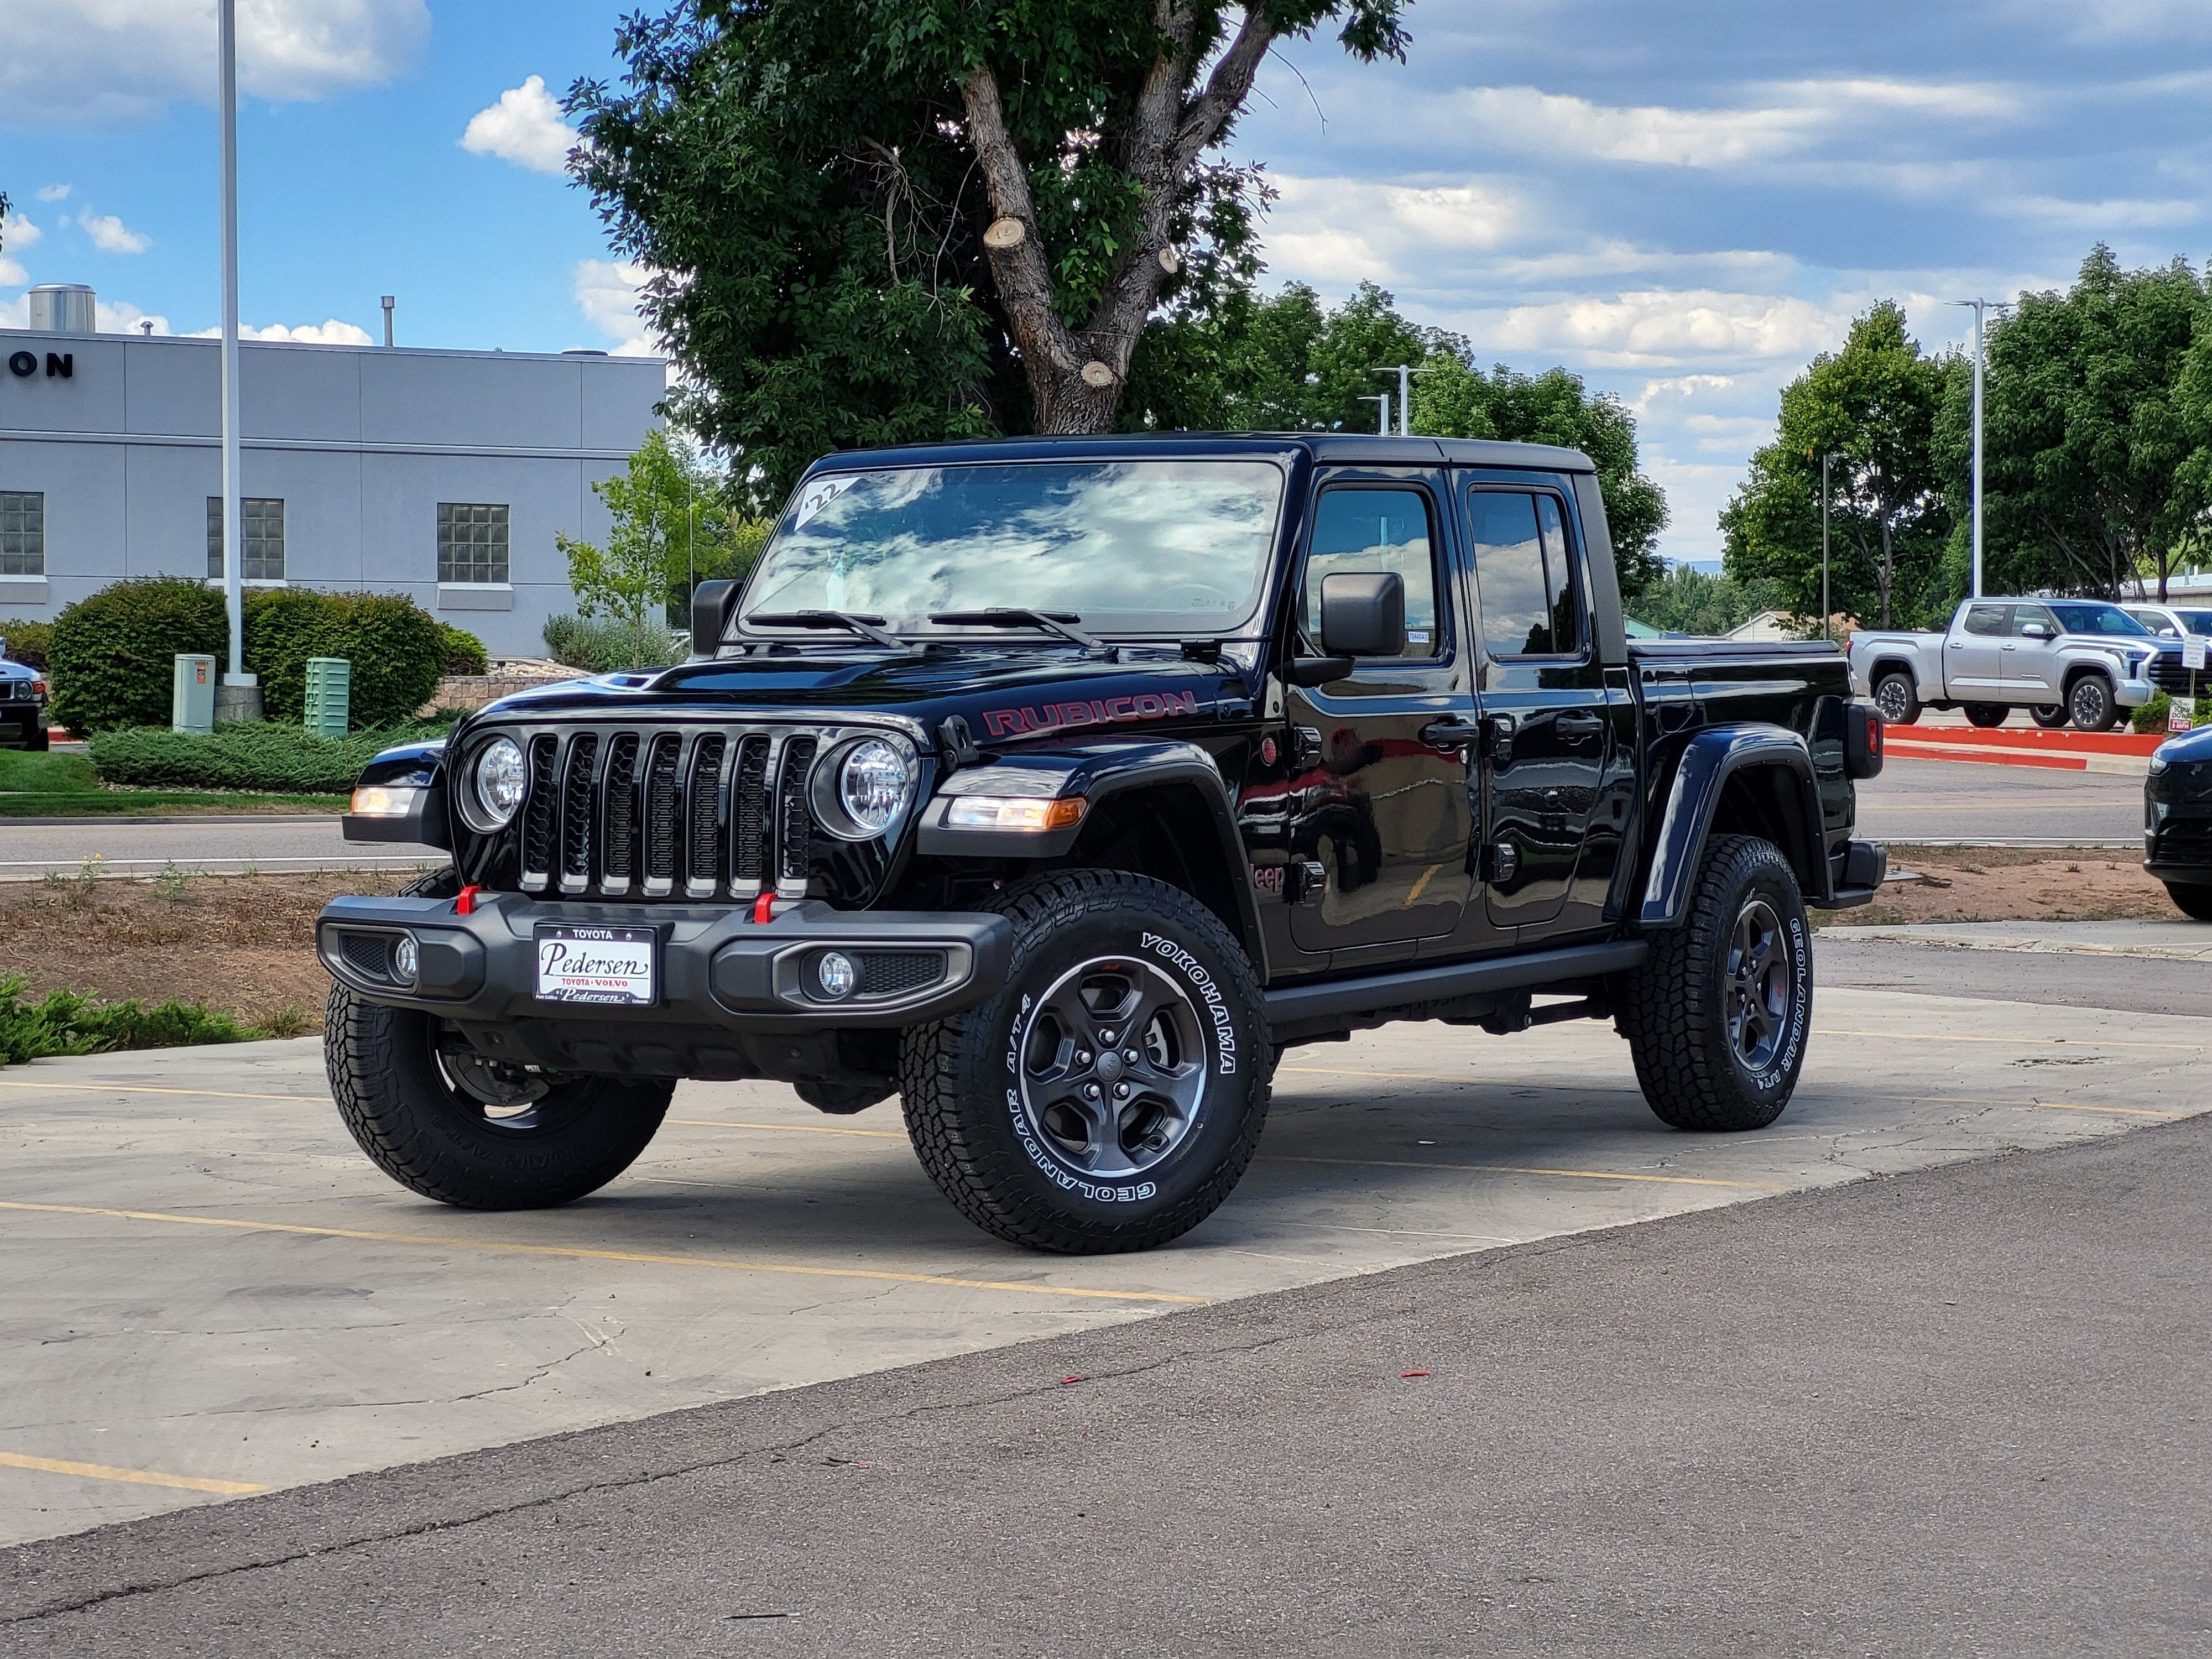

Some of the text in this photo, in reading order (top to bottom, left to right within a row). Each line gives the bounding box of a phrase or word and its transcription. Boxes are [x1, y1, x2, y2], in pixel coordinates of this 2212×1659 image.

[9, 351, 73, 378] ON
[805, 483, 841, 511] '22
[983, 690, 1199, 736] RUBICON
[572, 928, 613, 940] TOYOTA
[541, 942, 649, 977] Pedersen
[560, 988, 625, 1002] Pedersen
[561, 978, 628, 988] TOYOTA VOLVO
[1781, 917, 1807, 1073] GEOLANDAR
[1141, 932, 1237, 1075] YOKOHAMA
[1006, 1088, 1157, 1203] GEOLANDAR
